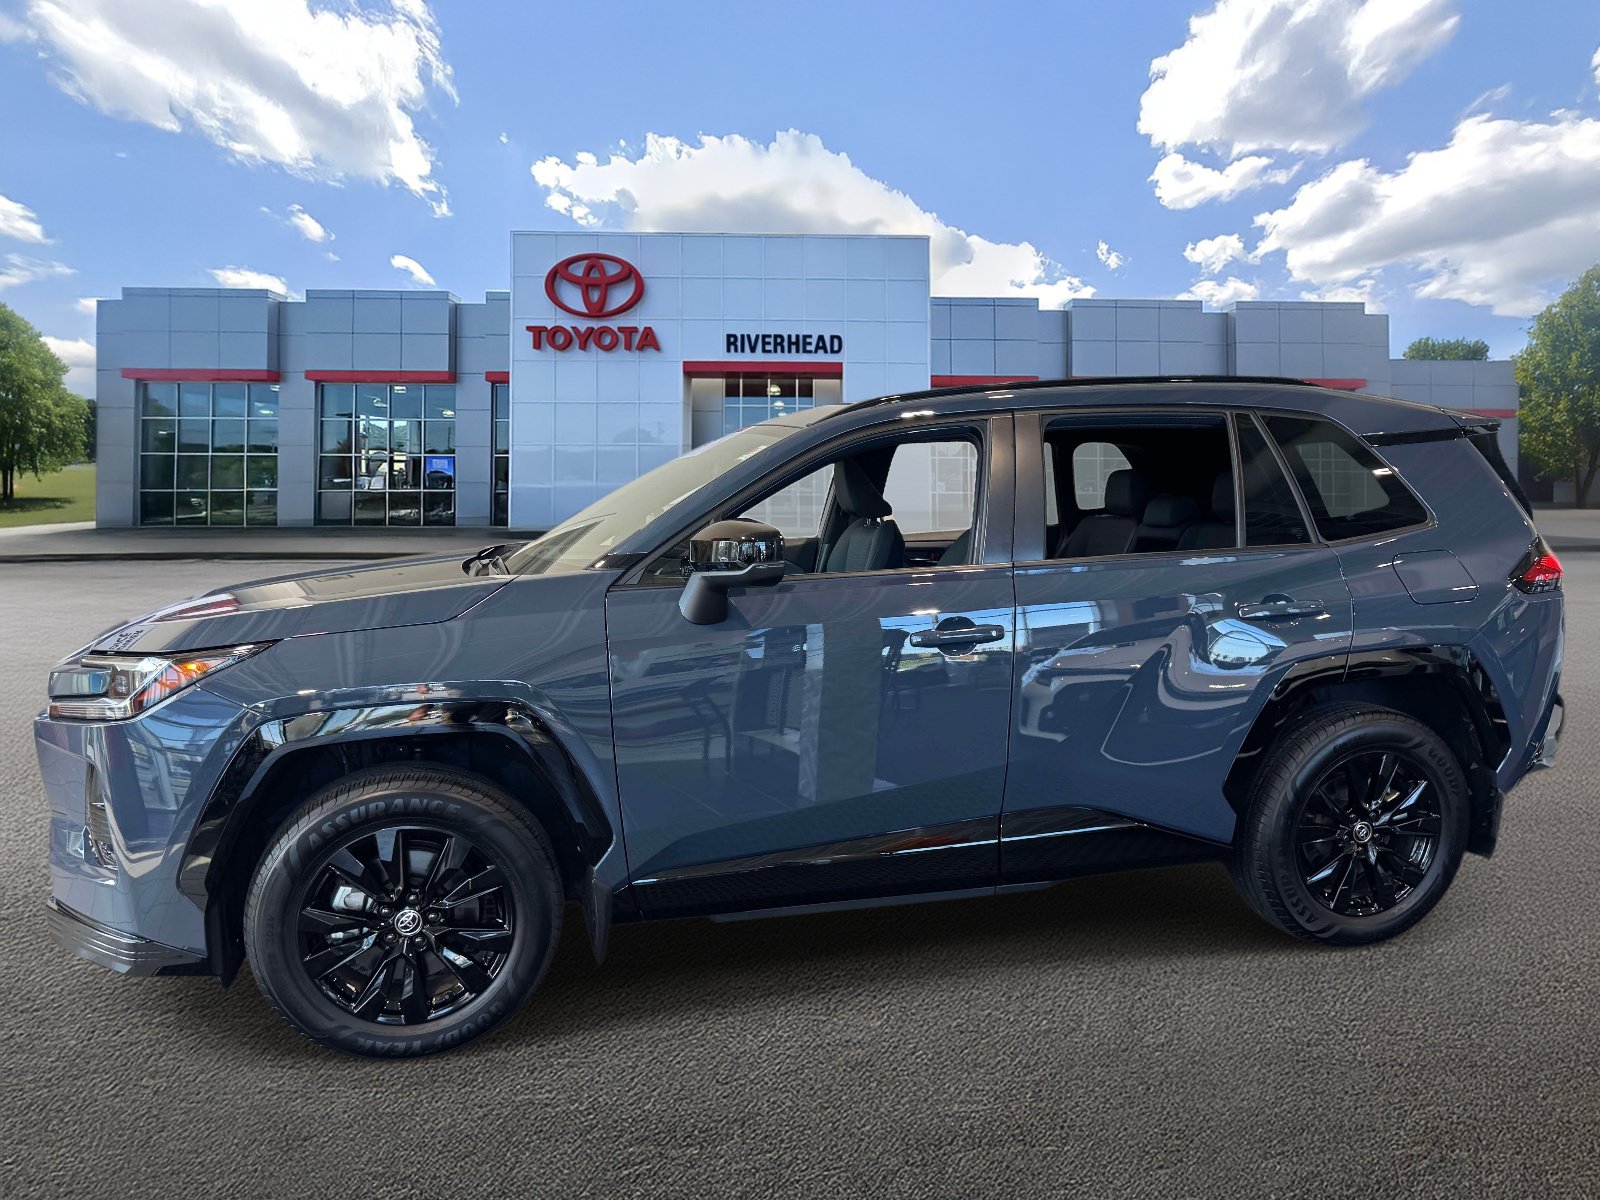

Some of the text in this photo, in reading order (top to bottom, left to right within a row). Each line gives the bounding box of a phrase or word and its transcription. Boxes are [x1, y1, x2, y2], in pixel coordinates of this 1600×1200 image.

[526, 325, 661, 353] TOYOTA
[726, 333, 843, 355] RIVERHEAD
[308, 797, 462, 849] ASSURANCE
